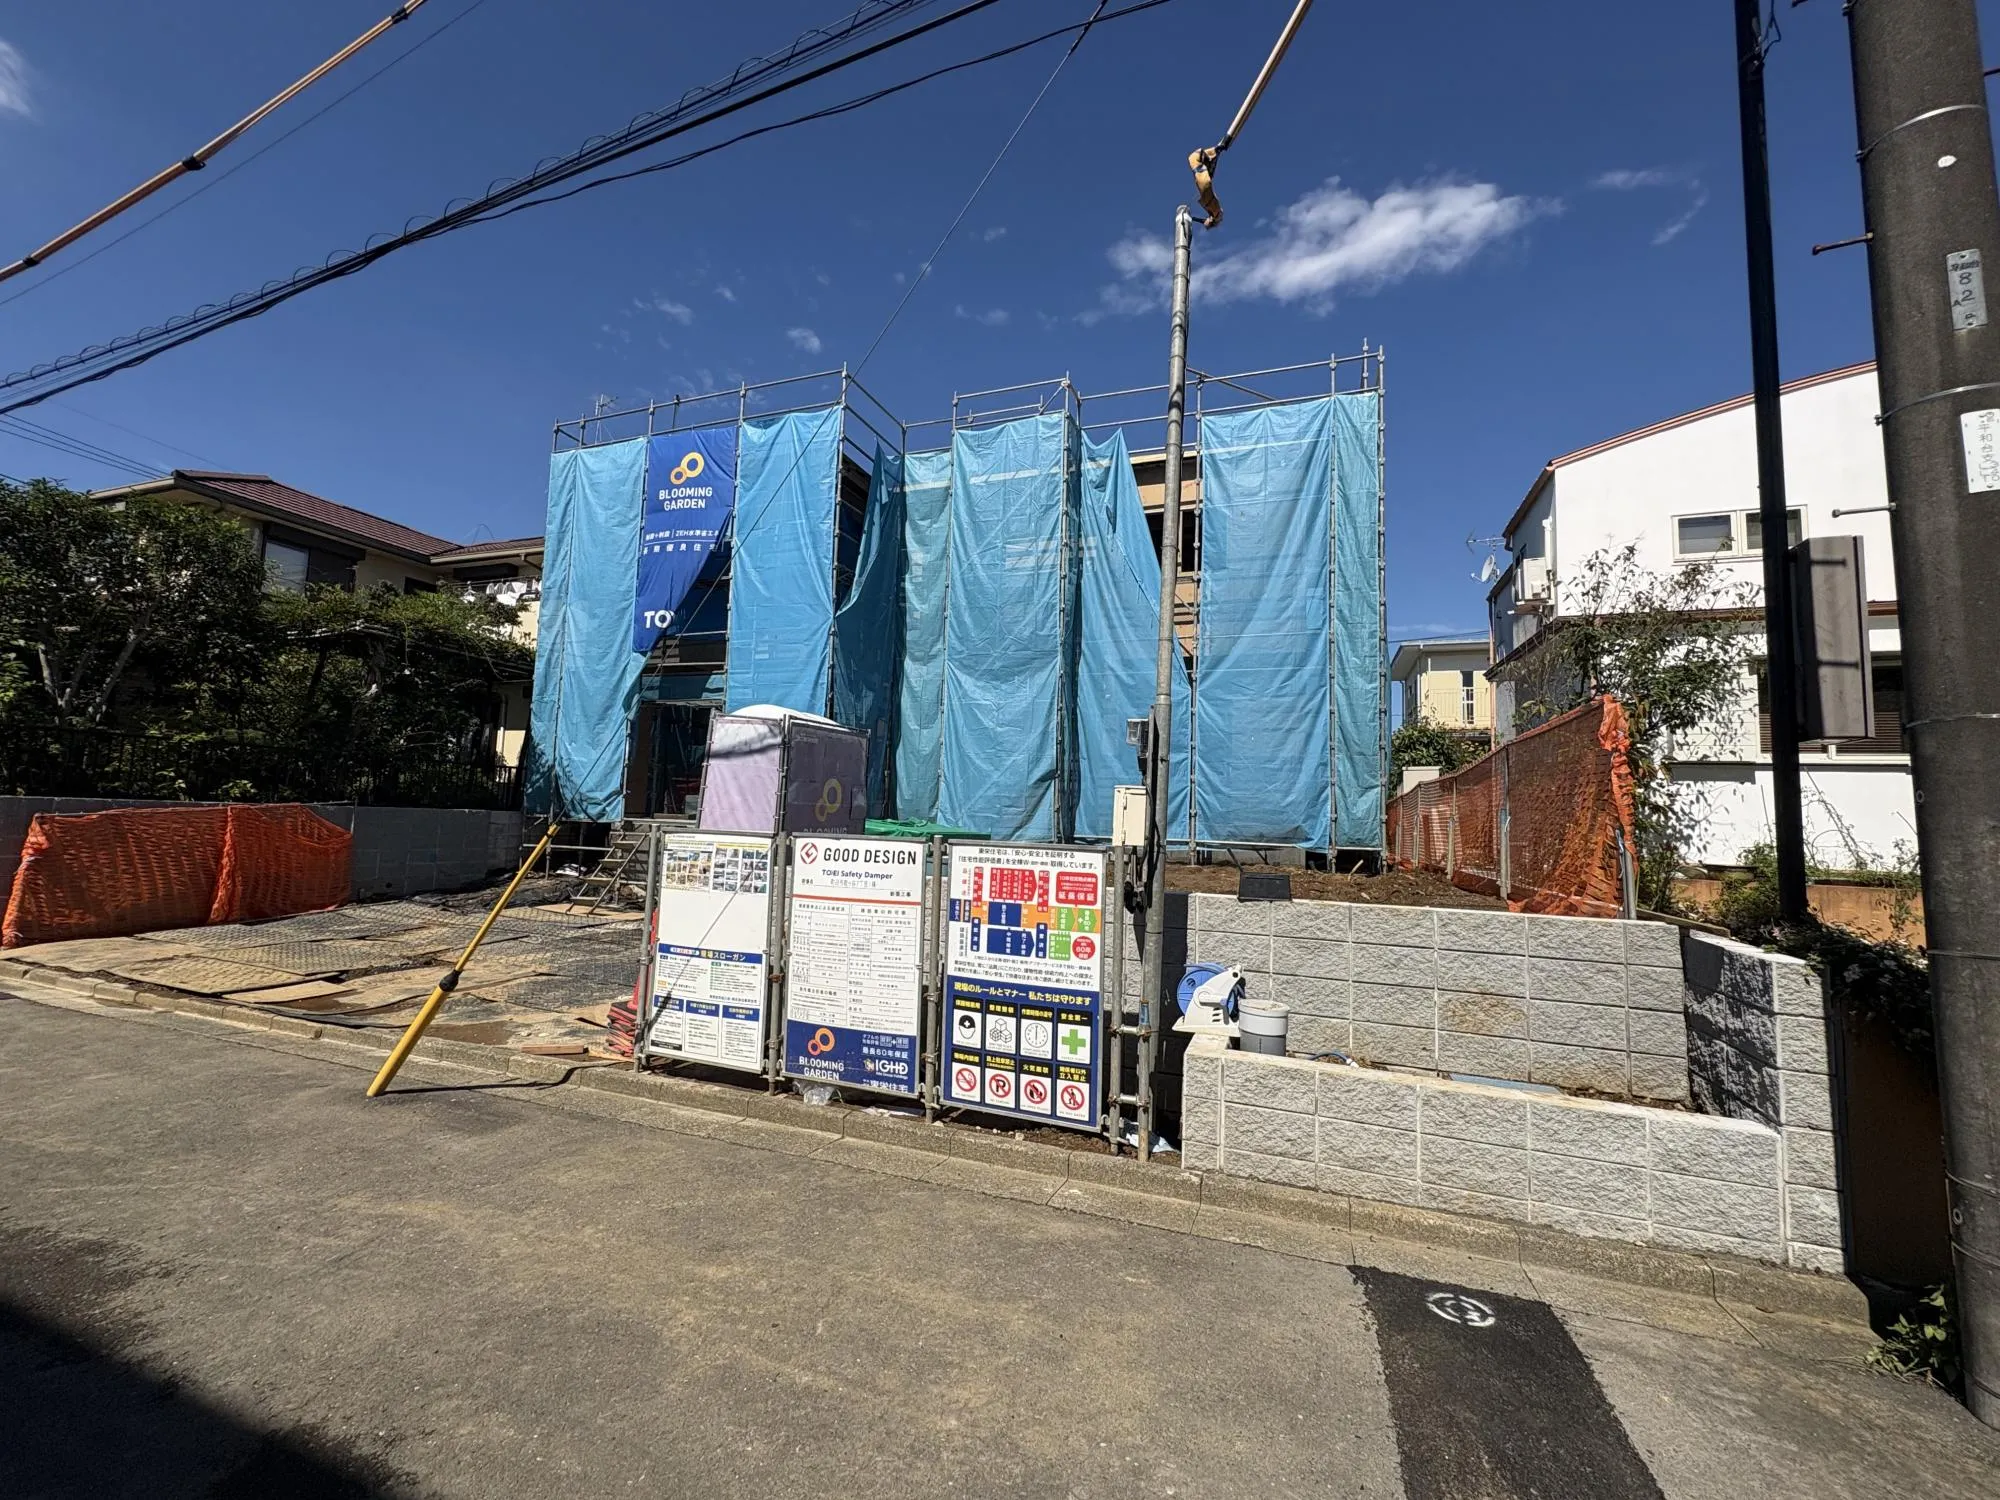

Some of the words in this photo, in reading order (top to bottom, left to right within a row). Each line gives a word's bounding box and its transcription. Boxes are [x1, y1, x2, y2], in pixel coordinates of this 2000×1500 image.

[659, 486, 713, 500] BLOOMING
[664, 498, 706, 511] GARDEN
[823, 847, 860, 862] GOOD
[864, 849, 917, 865] DESIGN
[841, 870, 863, 880] Safety
[864, 871, 893, 880] Damper
[953, 981, 1027, 998] 現場のルールとマナー
[1028, 991, 1092, 1006] 私たちは守ります
[1060, 1012, 1088, 1022] 安全第一
[798, 1055, 845, 1072] BLOOMING
[803, 1067, 840, 1080] GARDEN
